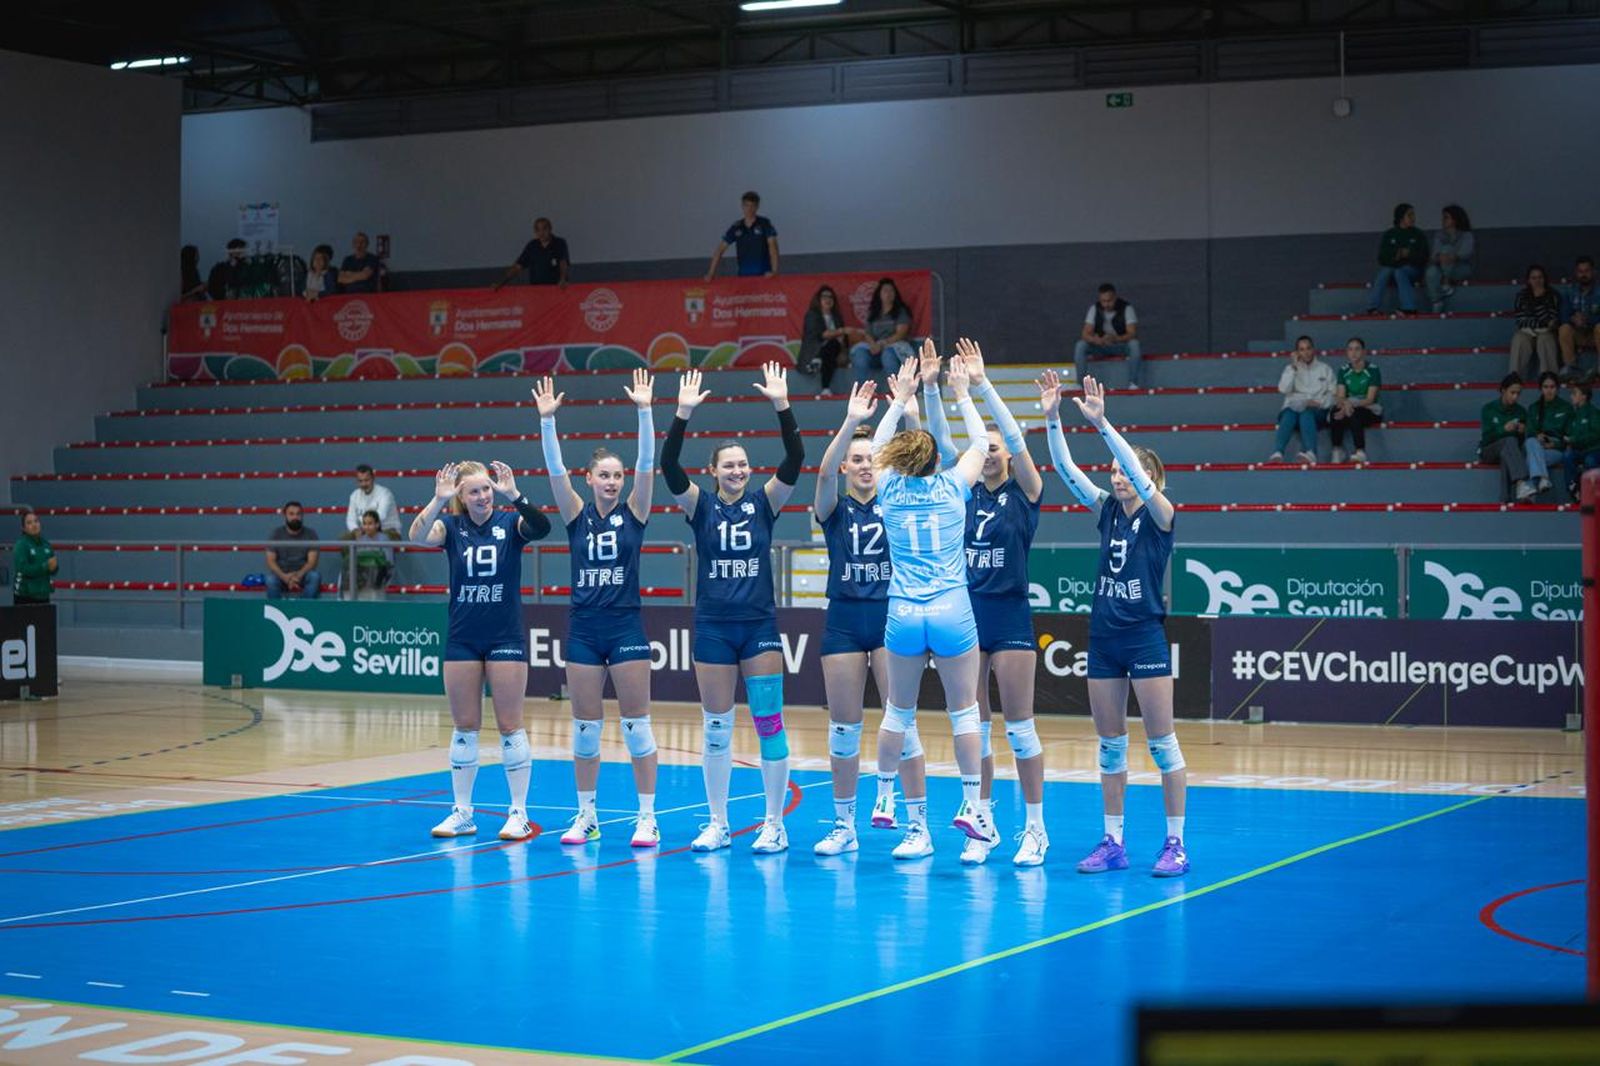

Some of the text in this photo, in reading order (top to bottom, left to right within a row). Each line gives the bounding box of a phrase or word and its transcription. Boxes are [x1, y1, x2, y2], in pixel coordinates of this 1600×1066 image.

[717, 519, 752, 551] 16
[848, 522, 884, 556] 12
[902, 513, 942, 557] 11
[976, 509, 996, 540] 7
[586, 530, 618, 561] 18
[965, 547, 1005, 569] TRE
[1109, 538, 1128, 574] 3
[463, 544, 497, 578] 19
[708, 557, 760, 579] JTRE
[841, 560, 891, 582] JTRE
[577, 566, 625, 588] JTRE
[1287, 578, 1384, 598] Diputación
[457, 583, 504, 603] JTRE
[353, 626, 440, 649] Diputación
[352, 648, 440, 677] Sevilla
